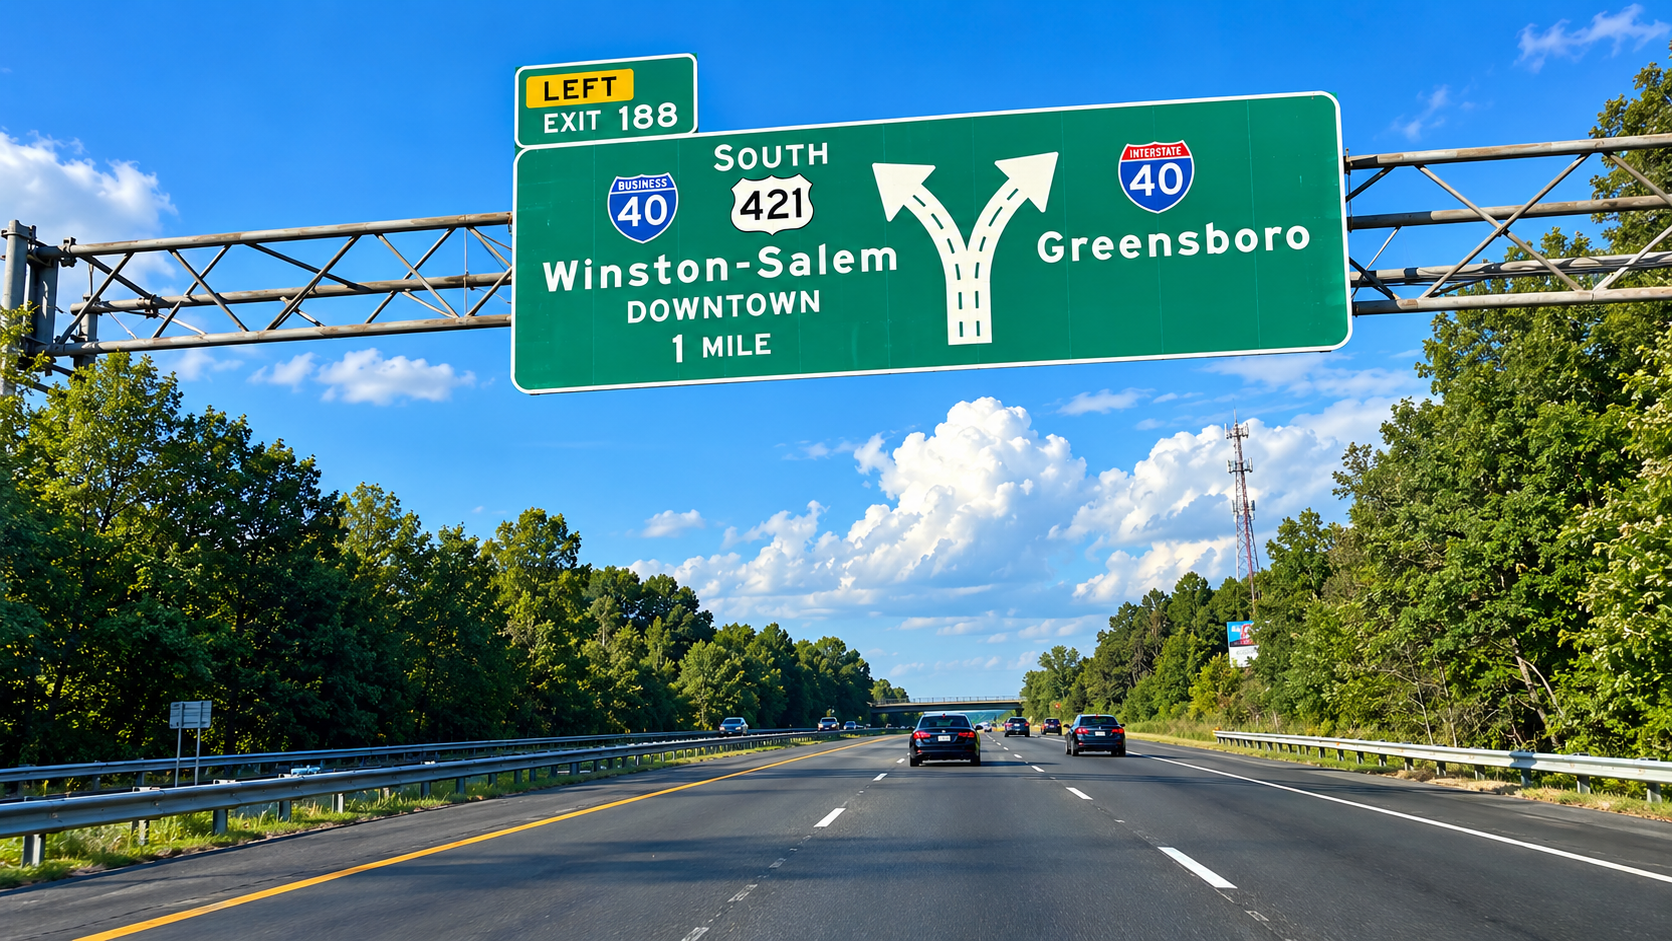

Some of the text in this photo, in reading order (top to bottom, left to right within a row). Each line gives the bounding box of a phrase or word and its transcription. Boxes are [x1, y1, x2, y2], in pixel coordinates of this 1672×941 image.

[544, 76, 617, 102] LEFT
[544, 102, 678, 133] EXIT 188
[714, 142, 828, 171] SOUTH
[1130, 146, 1182, 159] INTERSTATE
[618, 178, 668, 191] BUSINESS
[1129, 162, 1184, 197] 40
[617, 194, 668, 227] 40
[739, 187, 802, 221] 421
[1038, 223, 1310, 263] Greensboro
[543, 243, 897, 292] Winston-Salem
[627, 290, 820, 323] DOWNTOWN
[672, 333, 772, 363] 1 MILE
